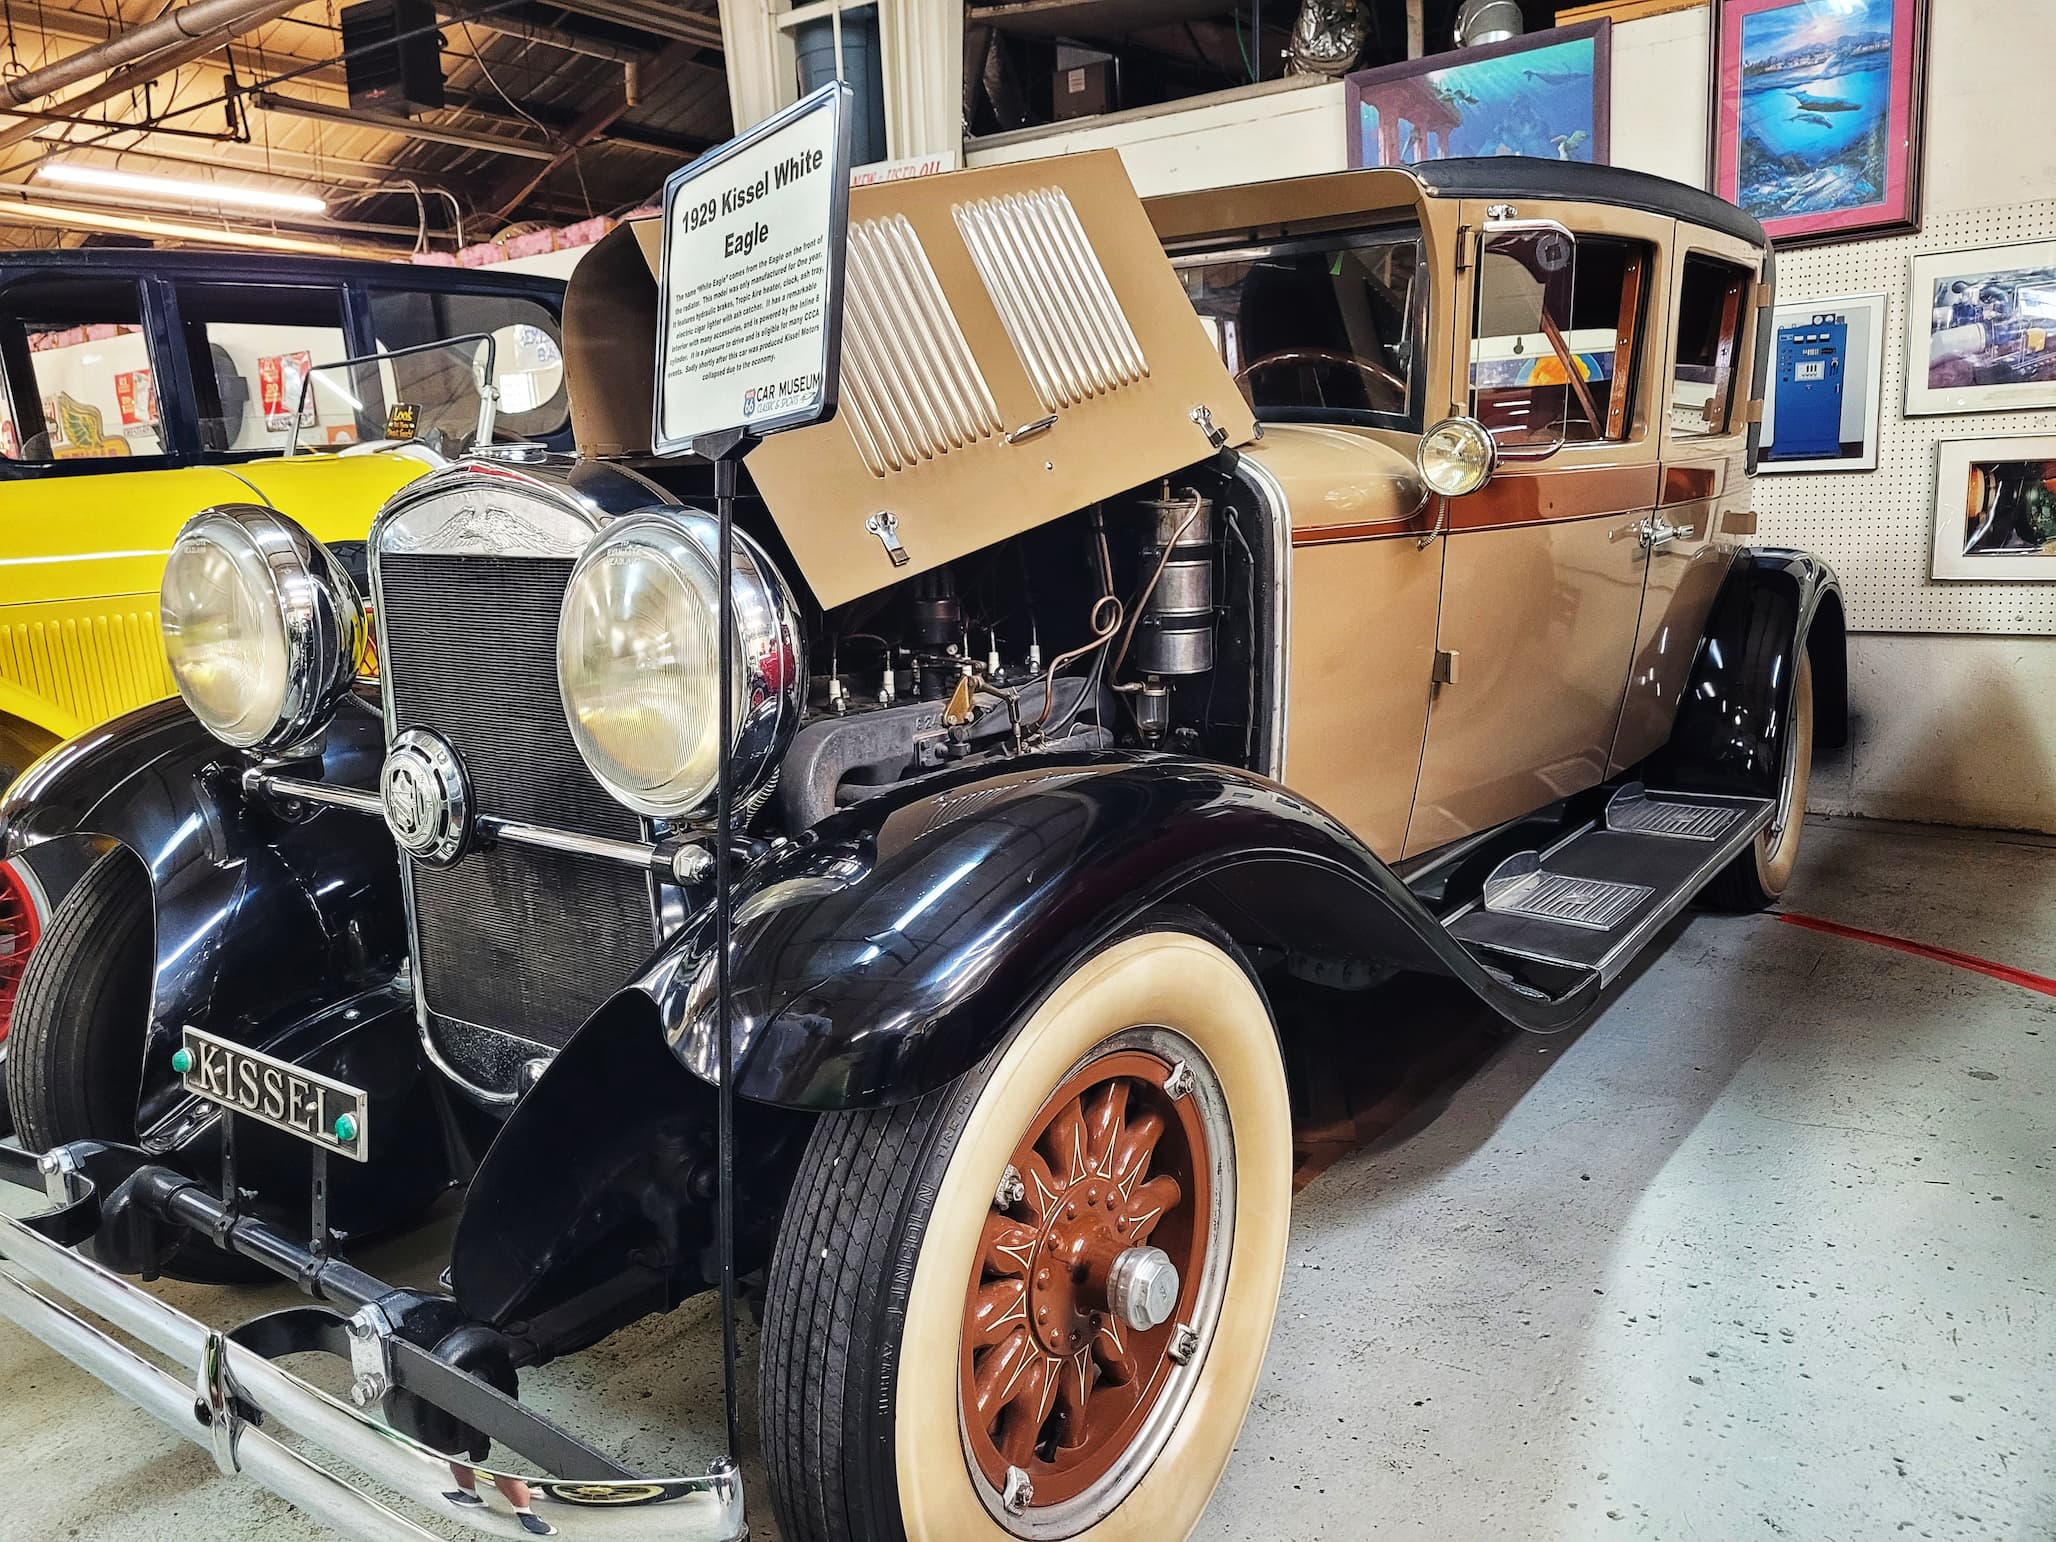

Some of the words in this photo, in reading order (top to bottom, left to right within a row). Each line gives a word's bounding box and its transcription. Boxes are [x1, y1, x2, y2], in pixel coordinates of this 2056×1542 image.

[682, 198, 717, 234] 1929
[722, 170, 769, 216] Kissel
[774, 149, 823, 190] White
[724, 221, 769, 258] Eagle
[676, 294, 684, 302] The
[685, 289, 696, 298] name
[729, 269, 745, 281] comes
[746, 264, 757, 273] from
[759, 260, 767, 268] the
[768, 253, 784, 265] Eagle
[793, 246, 802, 255] the
[803, 238, 816, 251] front
[817, 234, 823, 245] of
[683, 300, 701, 312] radiator.
[702, 295, 713, 304] This
[713, 288, 728, 300] model
[729, 285, 739, 293] was
[739, 280, 750, 290] only
[751, 264, 787, 285] manufactured
[788, 262, 796, 271] for
[797, 258, 808, 268] One
[808, 252, 823, 265] year.
[676, 328, 694, 340] electric
[694, 324, 706, 334] cigar
[707, 318, 722, 330] lighter
[722, 313, 733, 323] with
[733, 310, 742, 319] ash
[743, 303, 763, 316] catcher.
[766, 299, 770, 307] It
[771, 296, 781, 305] has
[786, 282, 817, 300] remarkable
[677, 315, 695, 326] features
[696, 306, 716, 321] hydraulic
[717, 301, 734, 312] brakes,
[735, 293, 751, 305] Tropic
[752, 289, 762, 299] Aire
[763, 282, 782, 294] heater,
[783, 274, 799, 287] clock,
[800, 269, 810, 280] ash
[811, 266, 824, 276] tray,
[689, 338, 699, 347] with
[700, 335, 713, 344] many
[713, 324, 742, 340] accessories,
[743, 319, 753, 329] and
[753, 317, 758, 325] is
[759, 308, 781, 325] powered
[782, 307, 788, 316] by
[789, 304, 798, 312] the
[799, 297, 815, 309] Inline
[816, 294, 820, 302] 8
[685, 363, 698, 373] Sadly
[698, 358, 715, 370] shortly
[716, 355, 728, 364] after
[728, 351, 738, 360] this
[739, 349, 748, 357] car
[759, 335, 784, 352] produced
[784, 329, 800, 343] Kissel
[801, 324, 819, 336] Motors
[704, 343, 725, 357] pleasure
[732, 337, 744, 346] drive
[745, 331, 755, 342] and
[761, 324, 780, 337] eligible
[780, 321, 788, 330] for
[789, 316, 803, 327] many
[804, 308, 819, 321] CCCA
[702, 367, 726, 381] collapsed
[726, 366, 736, 374] due
[742, 361, 751, 369] the
[751, 354, 775, 366] economy.
[756, 384, 775, 402] CAR
[779, 372, 820, 397] MUSEUM
[199, 1041, 339, 1144] KISSEL
[935, 1119, 961, 1159] TIRE
[887, 1182, 937, 1314] LINCOLN
